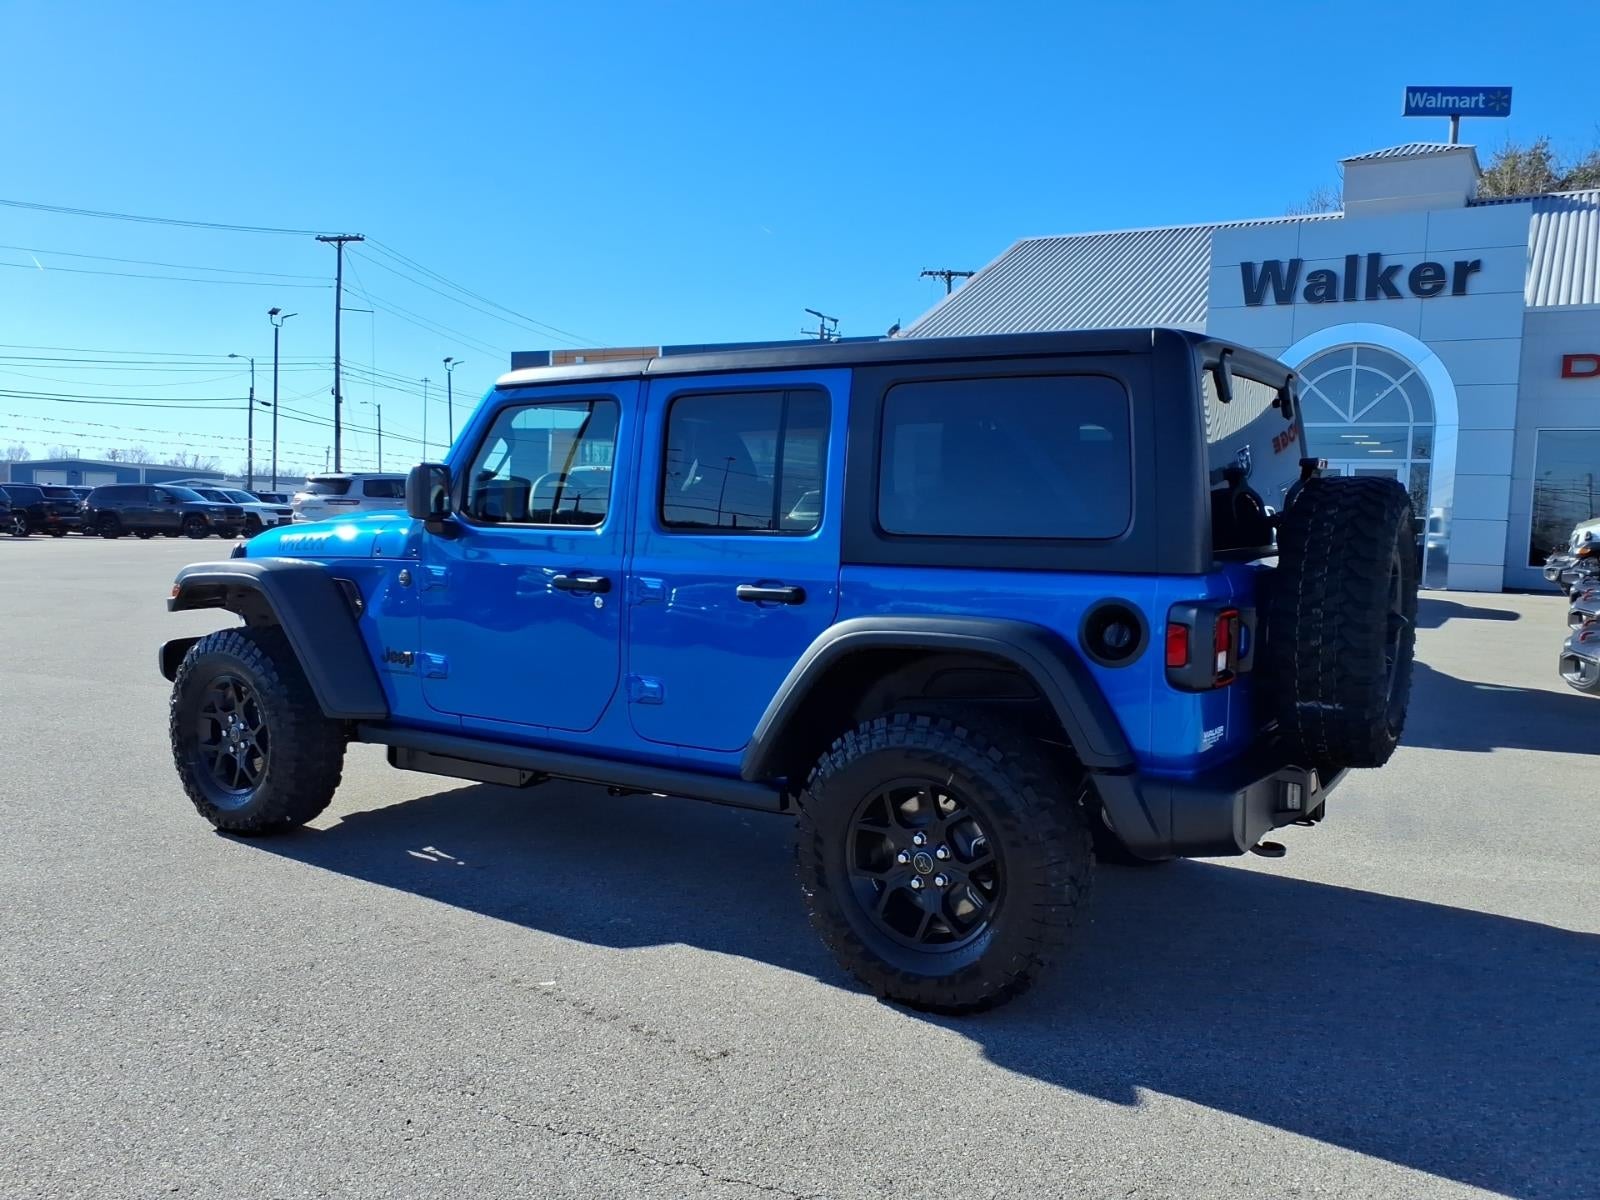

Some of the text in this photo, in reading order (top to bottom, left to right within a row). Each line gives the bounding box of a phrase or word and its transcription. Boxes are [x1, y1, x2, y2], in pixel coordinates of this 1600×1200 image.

[1408, 92, 1485, 108] Walmart
[1240, 252, 1481, 306] Walker
[381, 646, 415, 668] Jeep
